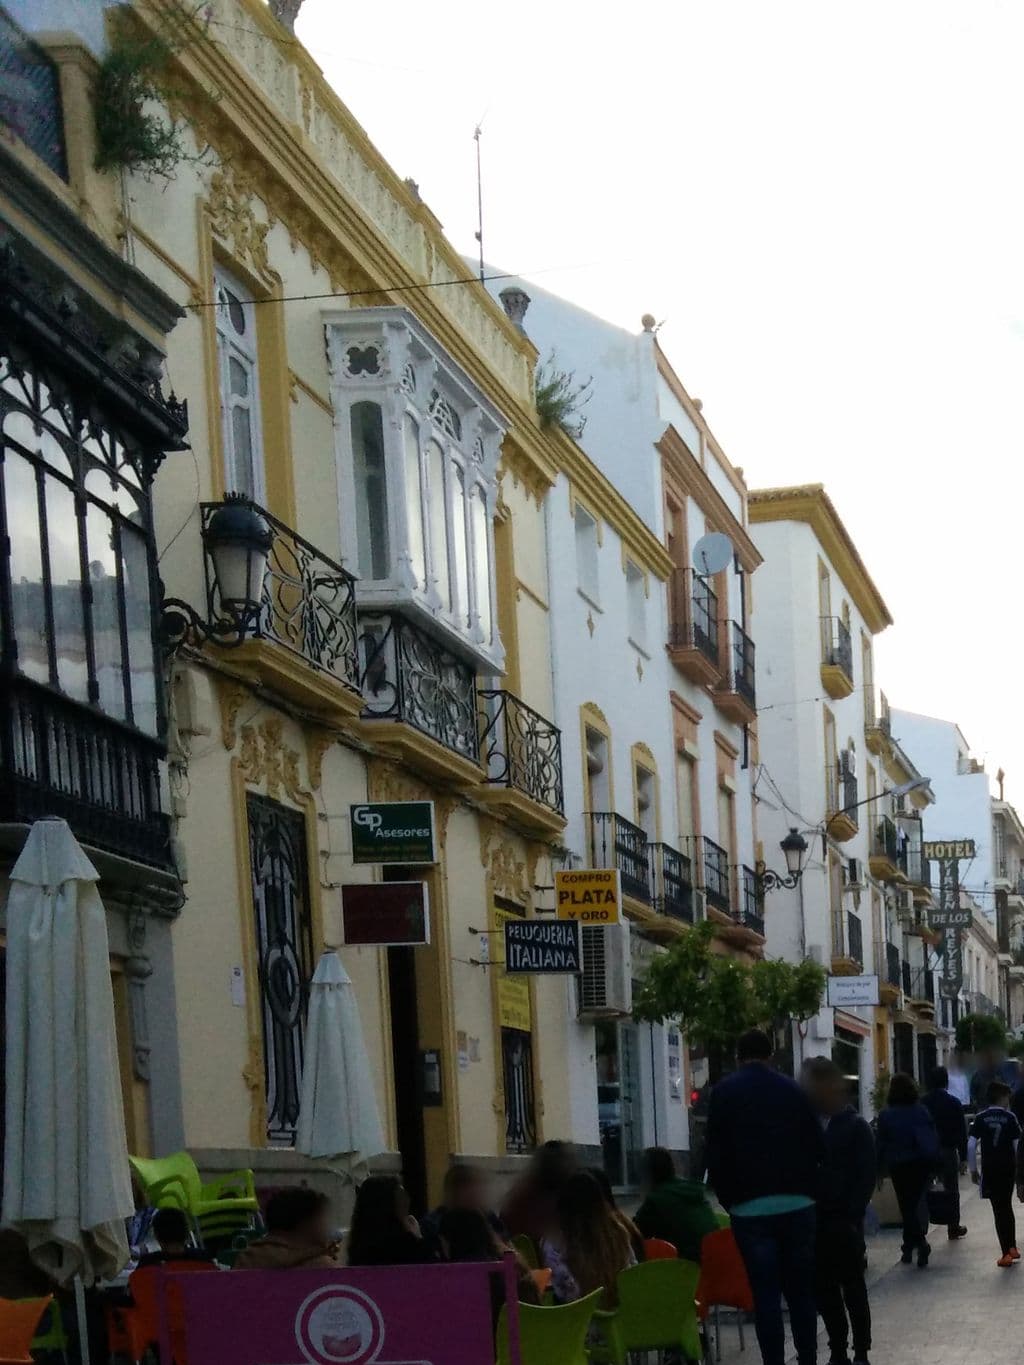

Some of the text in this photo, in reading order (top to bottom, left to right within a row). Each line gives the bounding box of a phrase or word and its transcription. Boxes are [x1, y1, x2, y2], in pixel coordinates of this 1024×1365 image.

[376, 827, 430, 837] Asesores
[924, 842, 974, 858] HOTEL
[562, 874, 611, 883] COMPRO
[558, 890, 616, 904] PLATA
[581, 911, 609, 920] ORO
[932, 914, 969, 924] DE LOS
[508, 925, 574, 946] PELUQUERIA
[509, 945, 576, 968] ITALIANA
[945, 928, 957, 980] REYES
